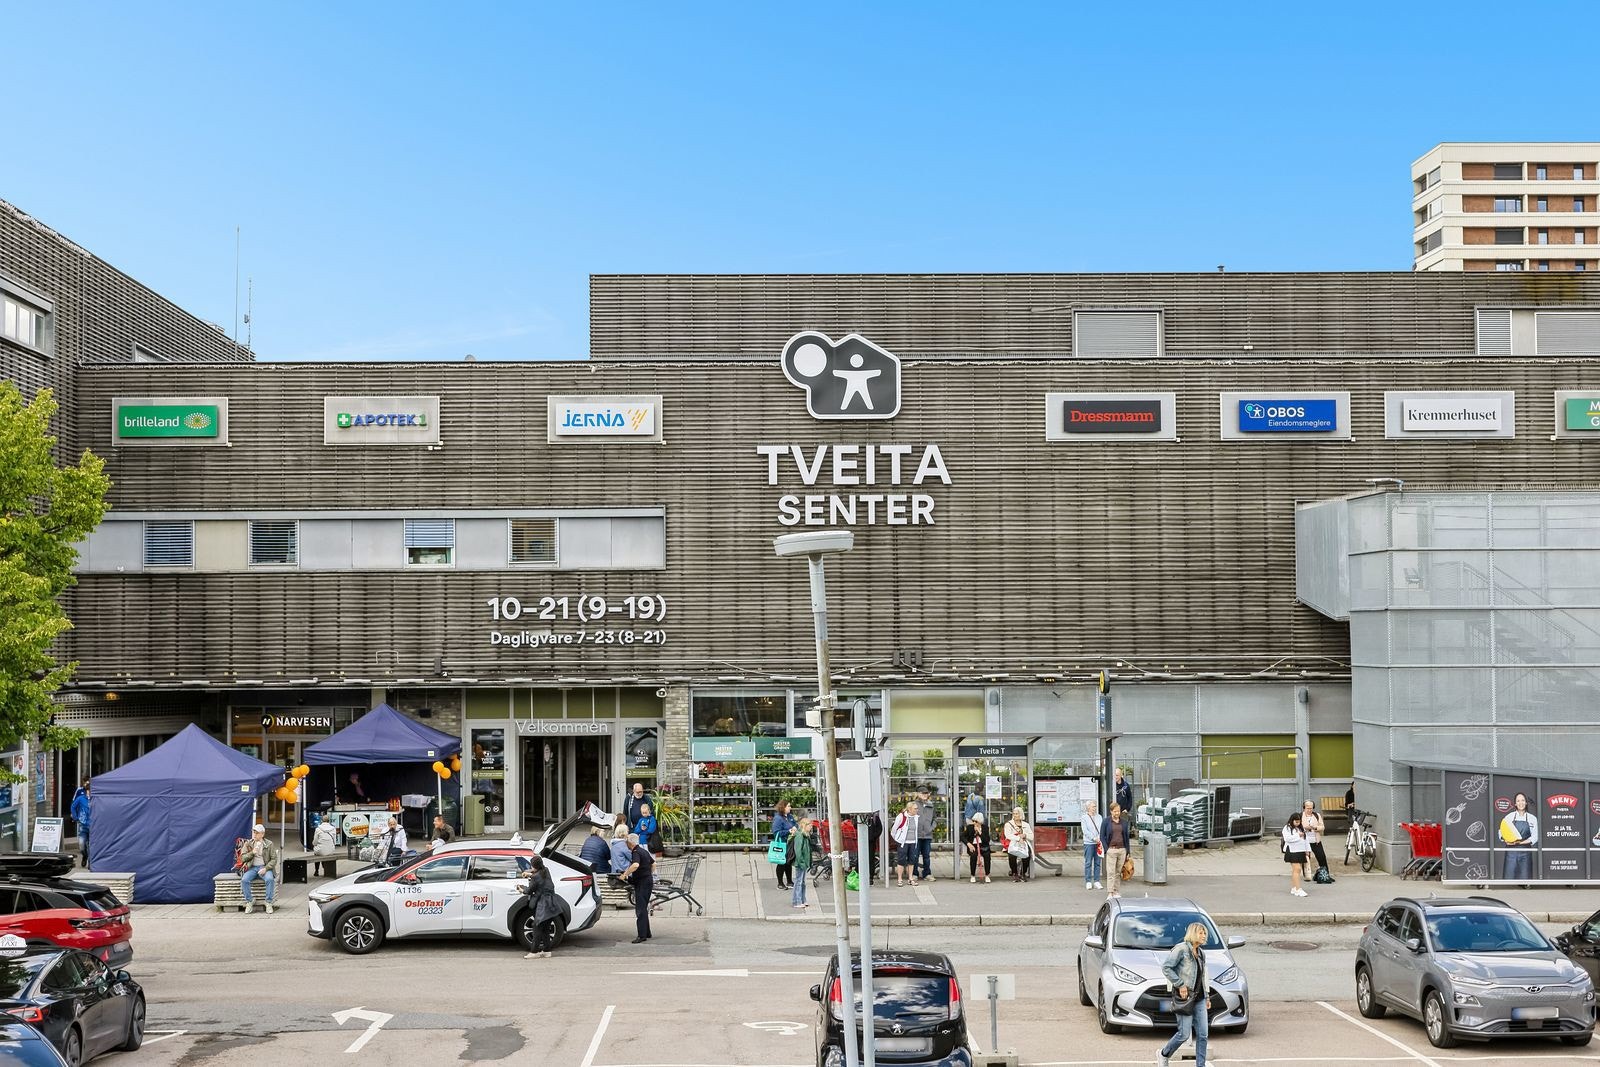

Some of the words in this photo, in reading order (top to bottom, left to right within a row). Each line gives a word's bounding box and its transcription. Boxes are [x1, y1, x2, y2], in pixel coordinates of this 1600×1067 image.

[1070, 410, 1154, 423] Dressmann
[1267, 407, 1305, 418] OBOS
[1408, 409, 1497, 421] Kremmerhuset
[124, 416, 180, 427] brilleland
[353, 413, 417, 427] APOTEK
[419, 413, 427, 427] 1
[1268, 420, 1331, 428] Eiendomsmeglere
[756, 445, 952, 485] TVEITA
[777, 495, 936, 526] SENTER
[490, 631, 573, 648] Dagligvare
[276, 717, 330, 726] NARVESEN
[515, 719, 608, 733] Velkommen
[979, 747, 1000, 755] Tveita
[1001, 747, 1006, 755] T
[405, 899, 444, 907] OsloTaxi
[472, 894, 488, 903] Taxi
[418, 906, 443, 915] 02323
